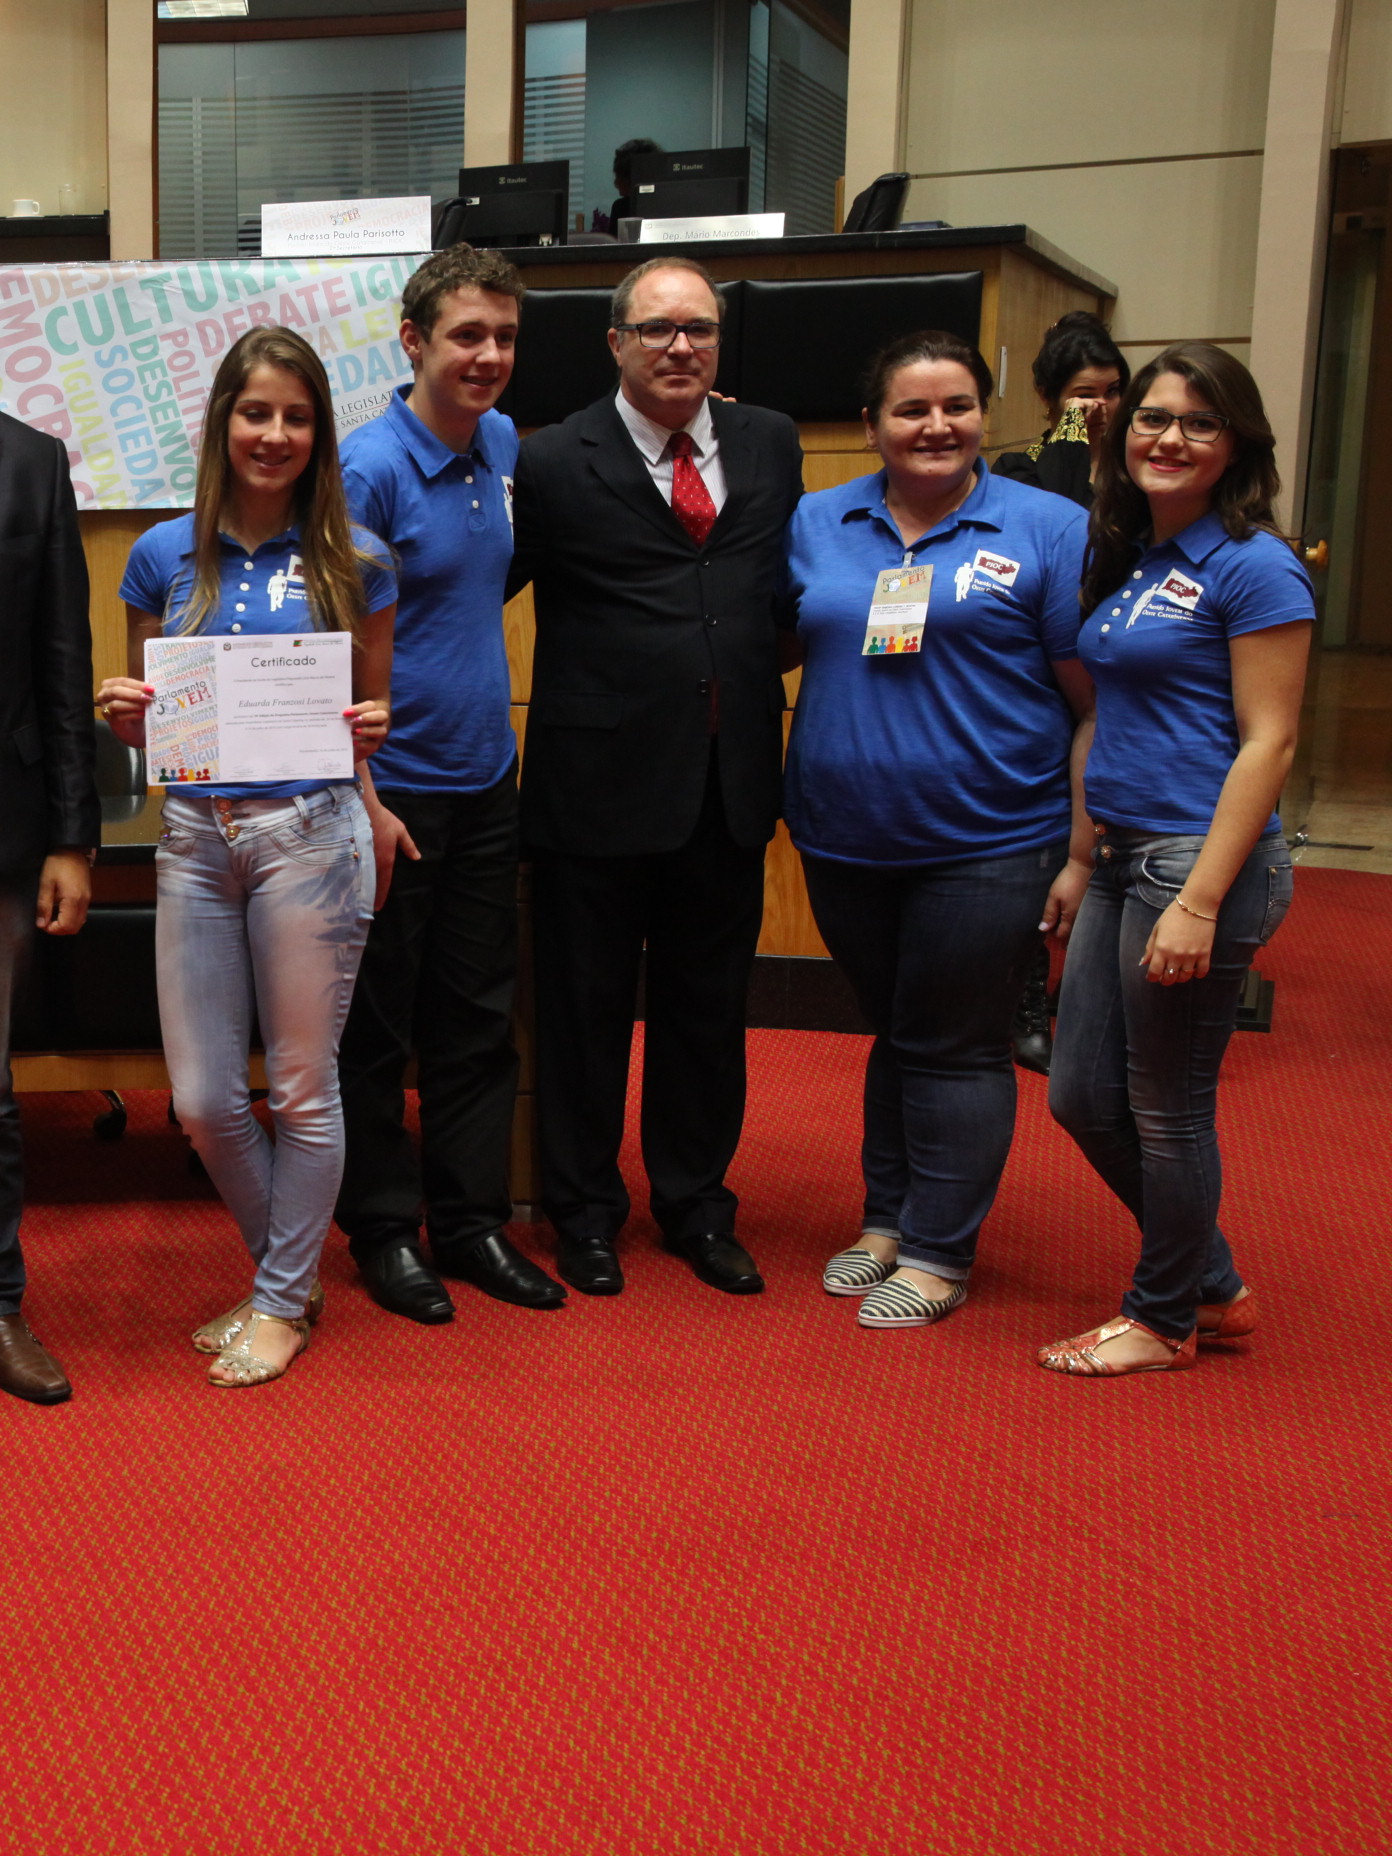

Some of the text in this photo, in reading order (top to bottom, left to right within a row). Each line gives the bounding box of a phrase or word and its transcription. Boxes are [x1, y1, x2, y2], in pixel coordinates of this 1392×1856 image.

[287, 228, 405, 242] Andressa Paula Parisotto
[662, 232, 682, 243] Dep.
[712, 227, 761, 239] Marcondes
[349, 255, 434, 308] IGU
[44, 258, 302, 357] CULTURA
[195, 275, 353, 358] DEBATE
[340, 414, 371, 428] SANTA
[985, 560, 1004, 571] PJOC
[250, 655, 317, 668] Certificado
[152, 680, 207, 704] Parlamento
[238, 699, 271, 708] Eduarda
